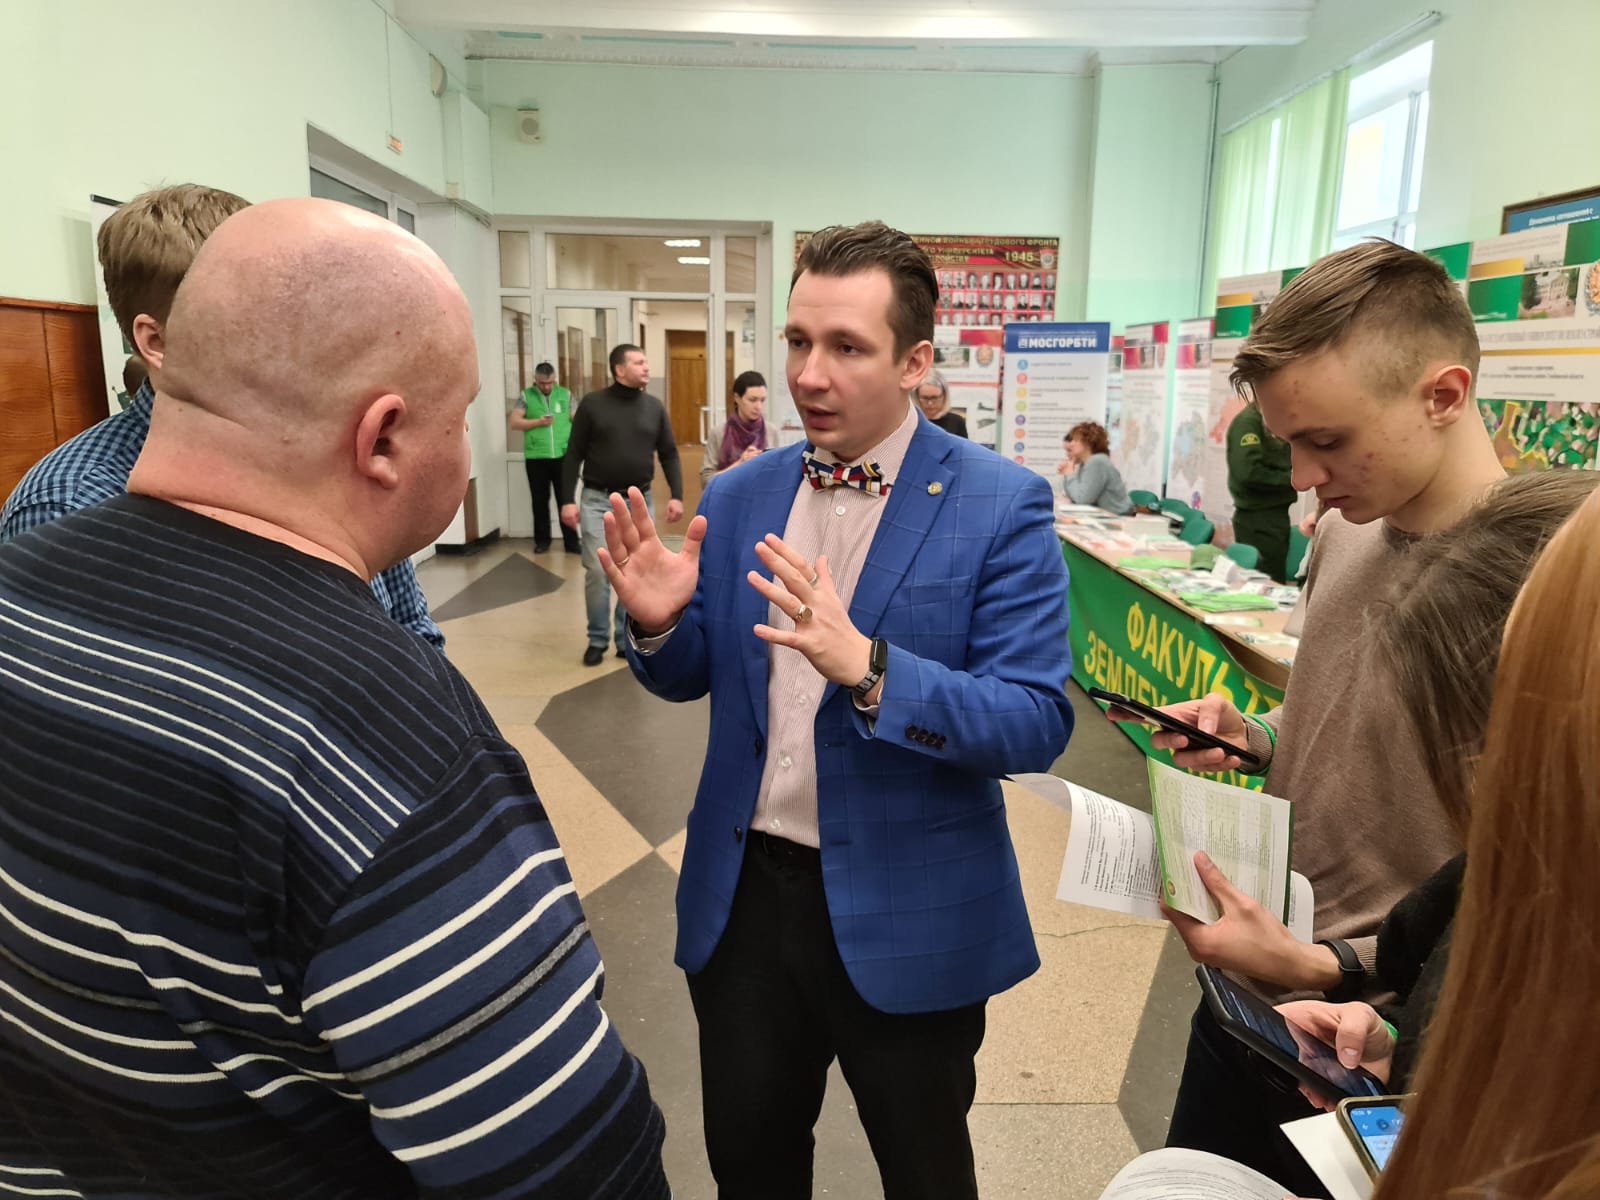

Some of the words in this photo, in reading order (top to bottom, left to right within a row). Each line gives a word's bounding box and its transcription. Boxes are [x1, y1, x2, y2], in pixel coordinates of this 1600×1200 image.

[1026, 238, 1059, 246] ФРОНТА
[1005, 251, 1035, 262] 1945
[1029, 337, 1097, 348] МОСГОРБТИ
